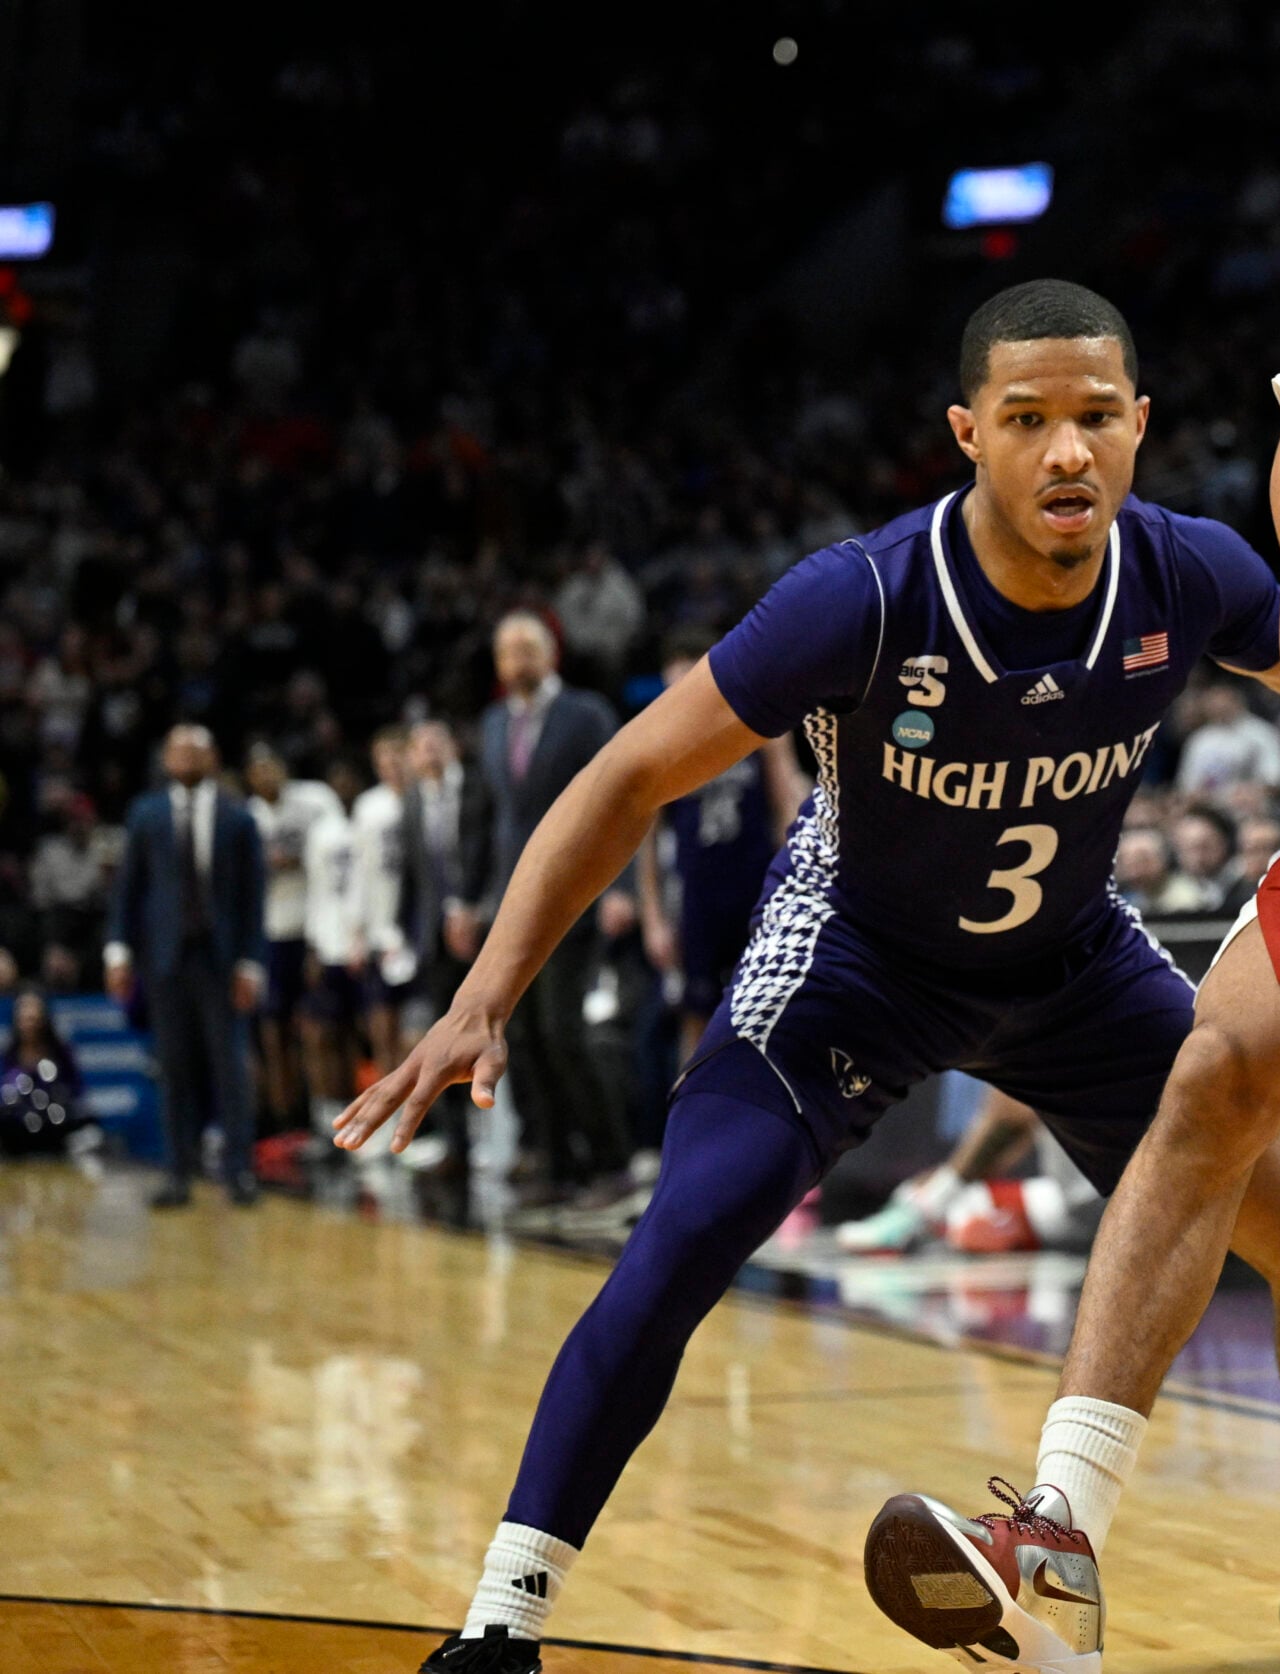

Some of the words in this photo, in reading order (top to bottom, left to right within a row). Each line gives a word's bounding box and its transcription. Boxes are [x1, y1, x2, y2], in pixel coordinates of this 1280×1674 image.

[900, 666, 925, 678] BIG
[1020, 690, 1065, 705] adidas
[897, 727, 931, 741] NCAA
[882, 741, 1010, 810] HIGH
[1019, 720, 1161, 808] POINT
[958, 823, 1059, 934] 3
